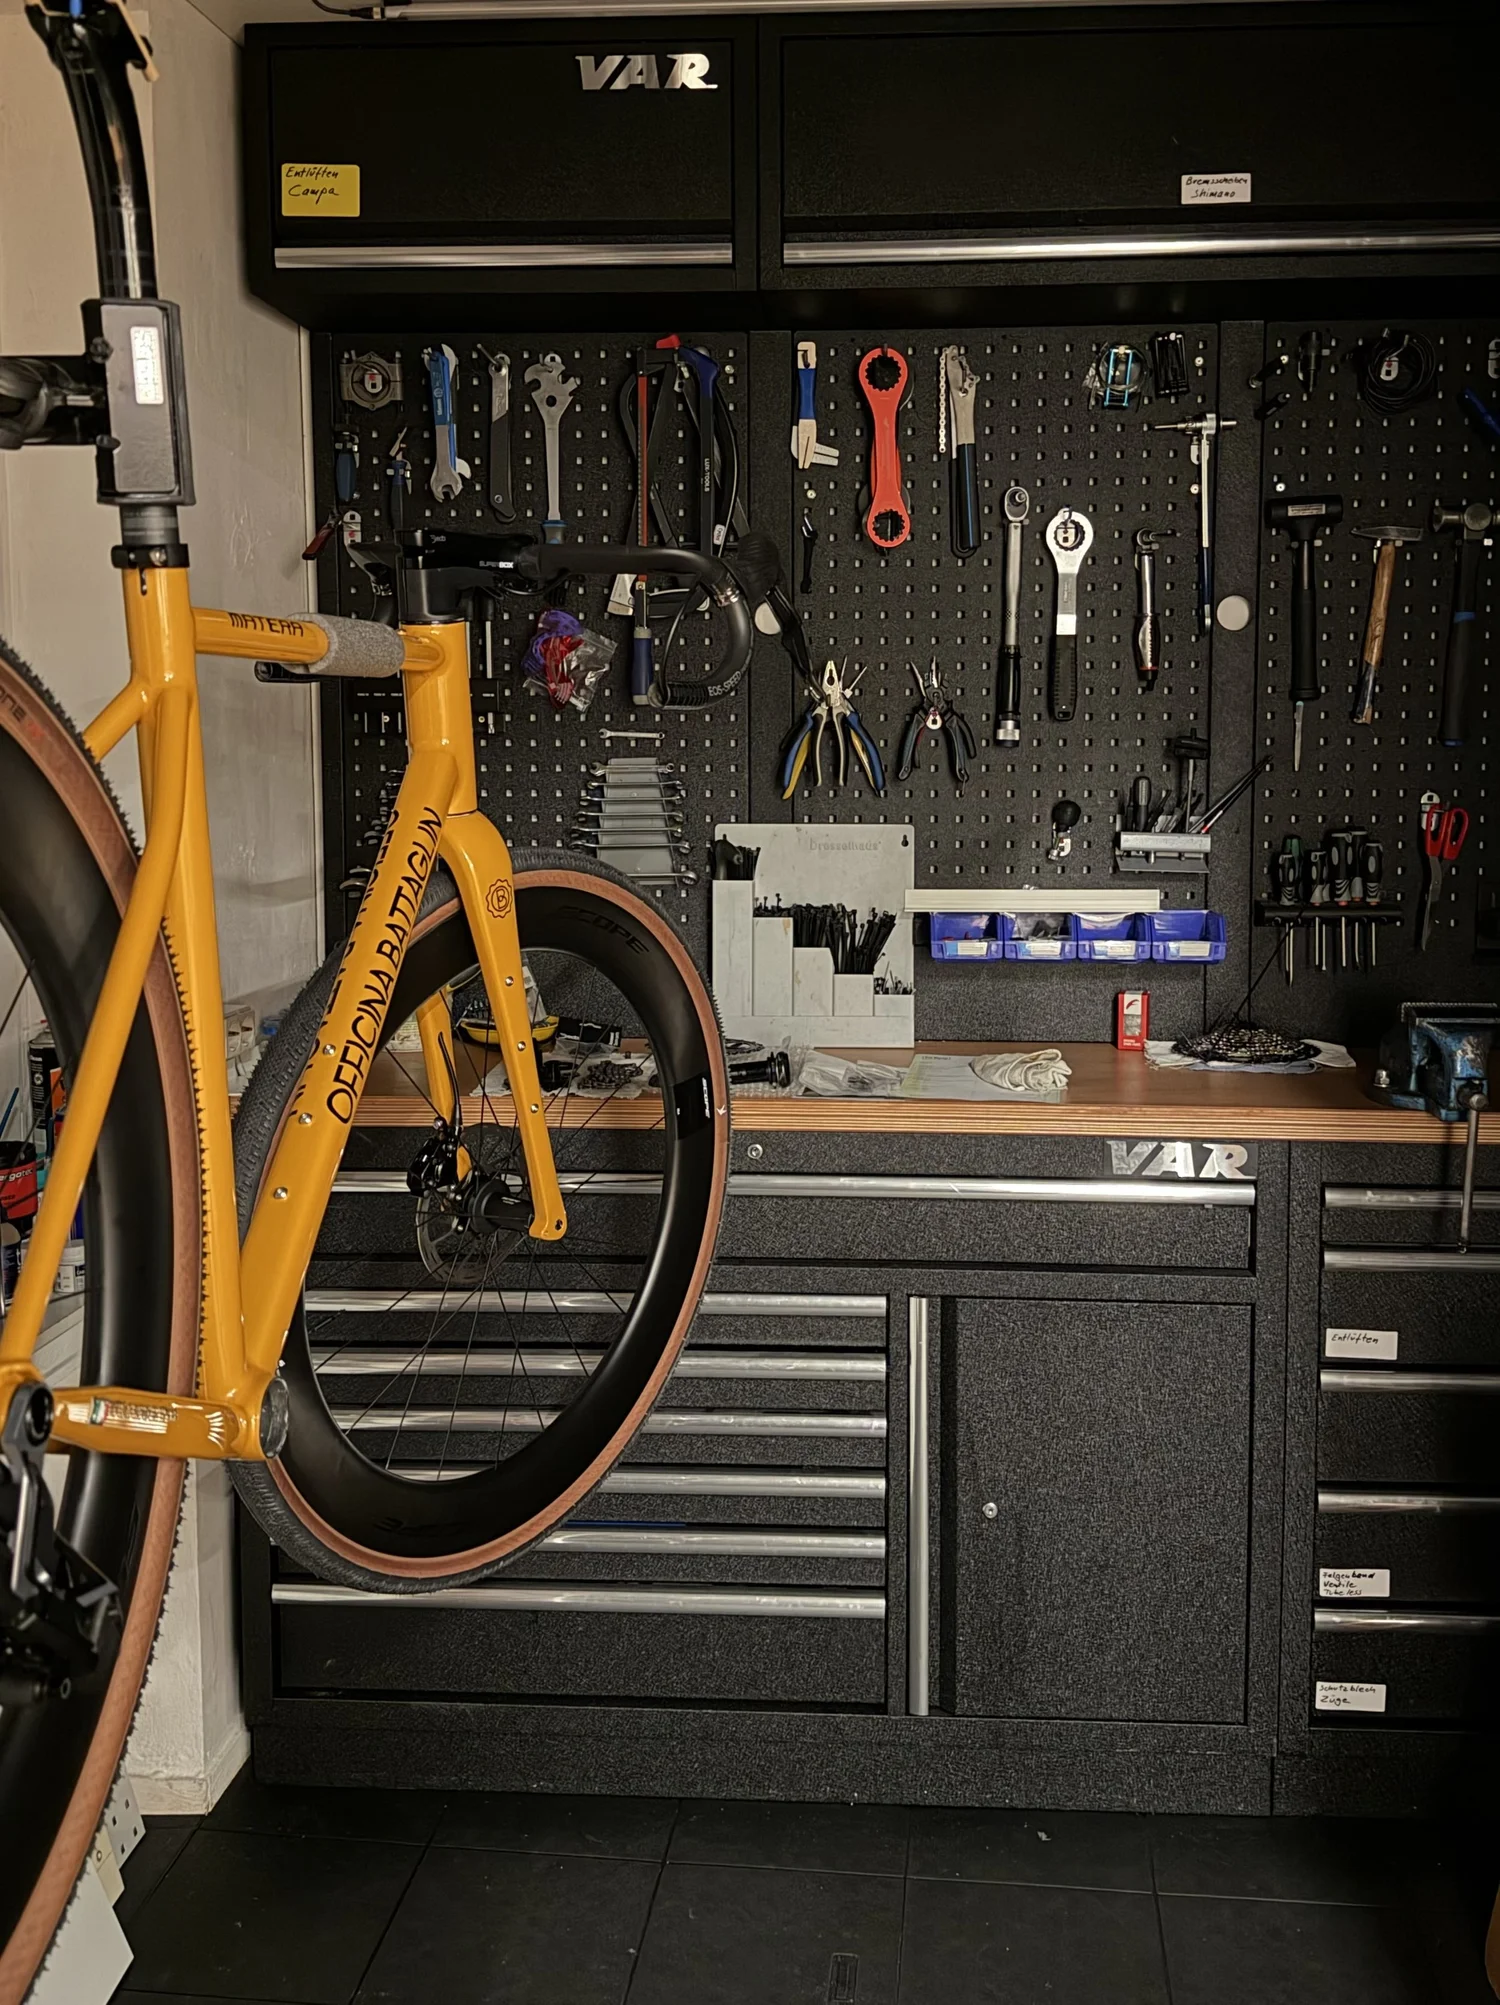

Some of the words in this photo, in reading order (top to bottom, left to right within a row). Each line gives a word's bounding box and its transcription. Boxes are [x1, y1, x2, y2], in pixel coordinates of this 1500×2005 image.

[575, 53, 718, 90] VAR
[285, 166, 339, 180] Entlüften
[288, 184, 340, 205] Campa
[227, 612, 304, 637] MATERA
[326, 968, 394, 1125] OFFICINA
[376, 806, 443, 969] BATTAGLIN
[1106, 1140, 1256, 1179] VAR
[1331, 1332, 1379, 1345] Entlüften
[1320, 1694, 1351, 1707] Züge
